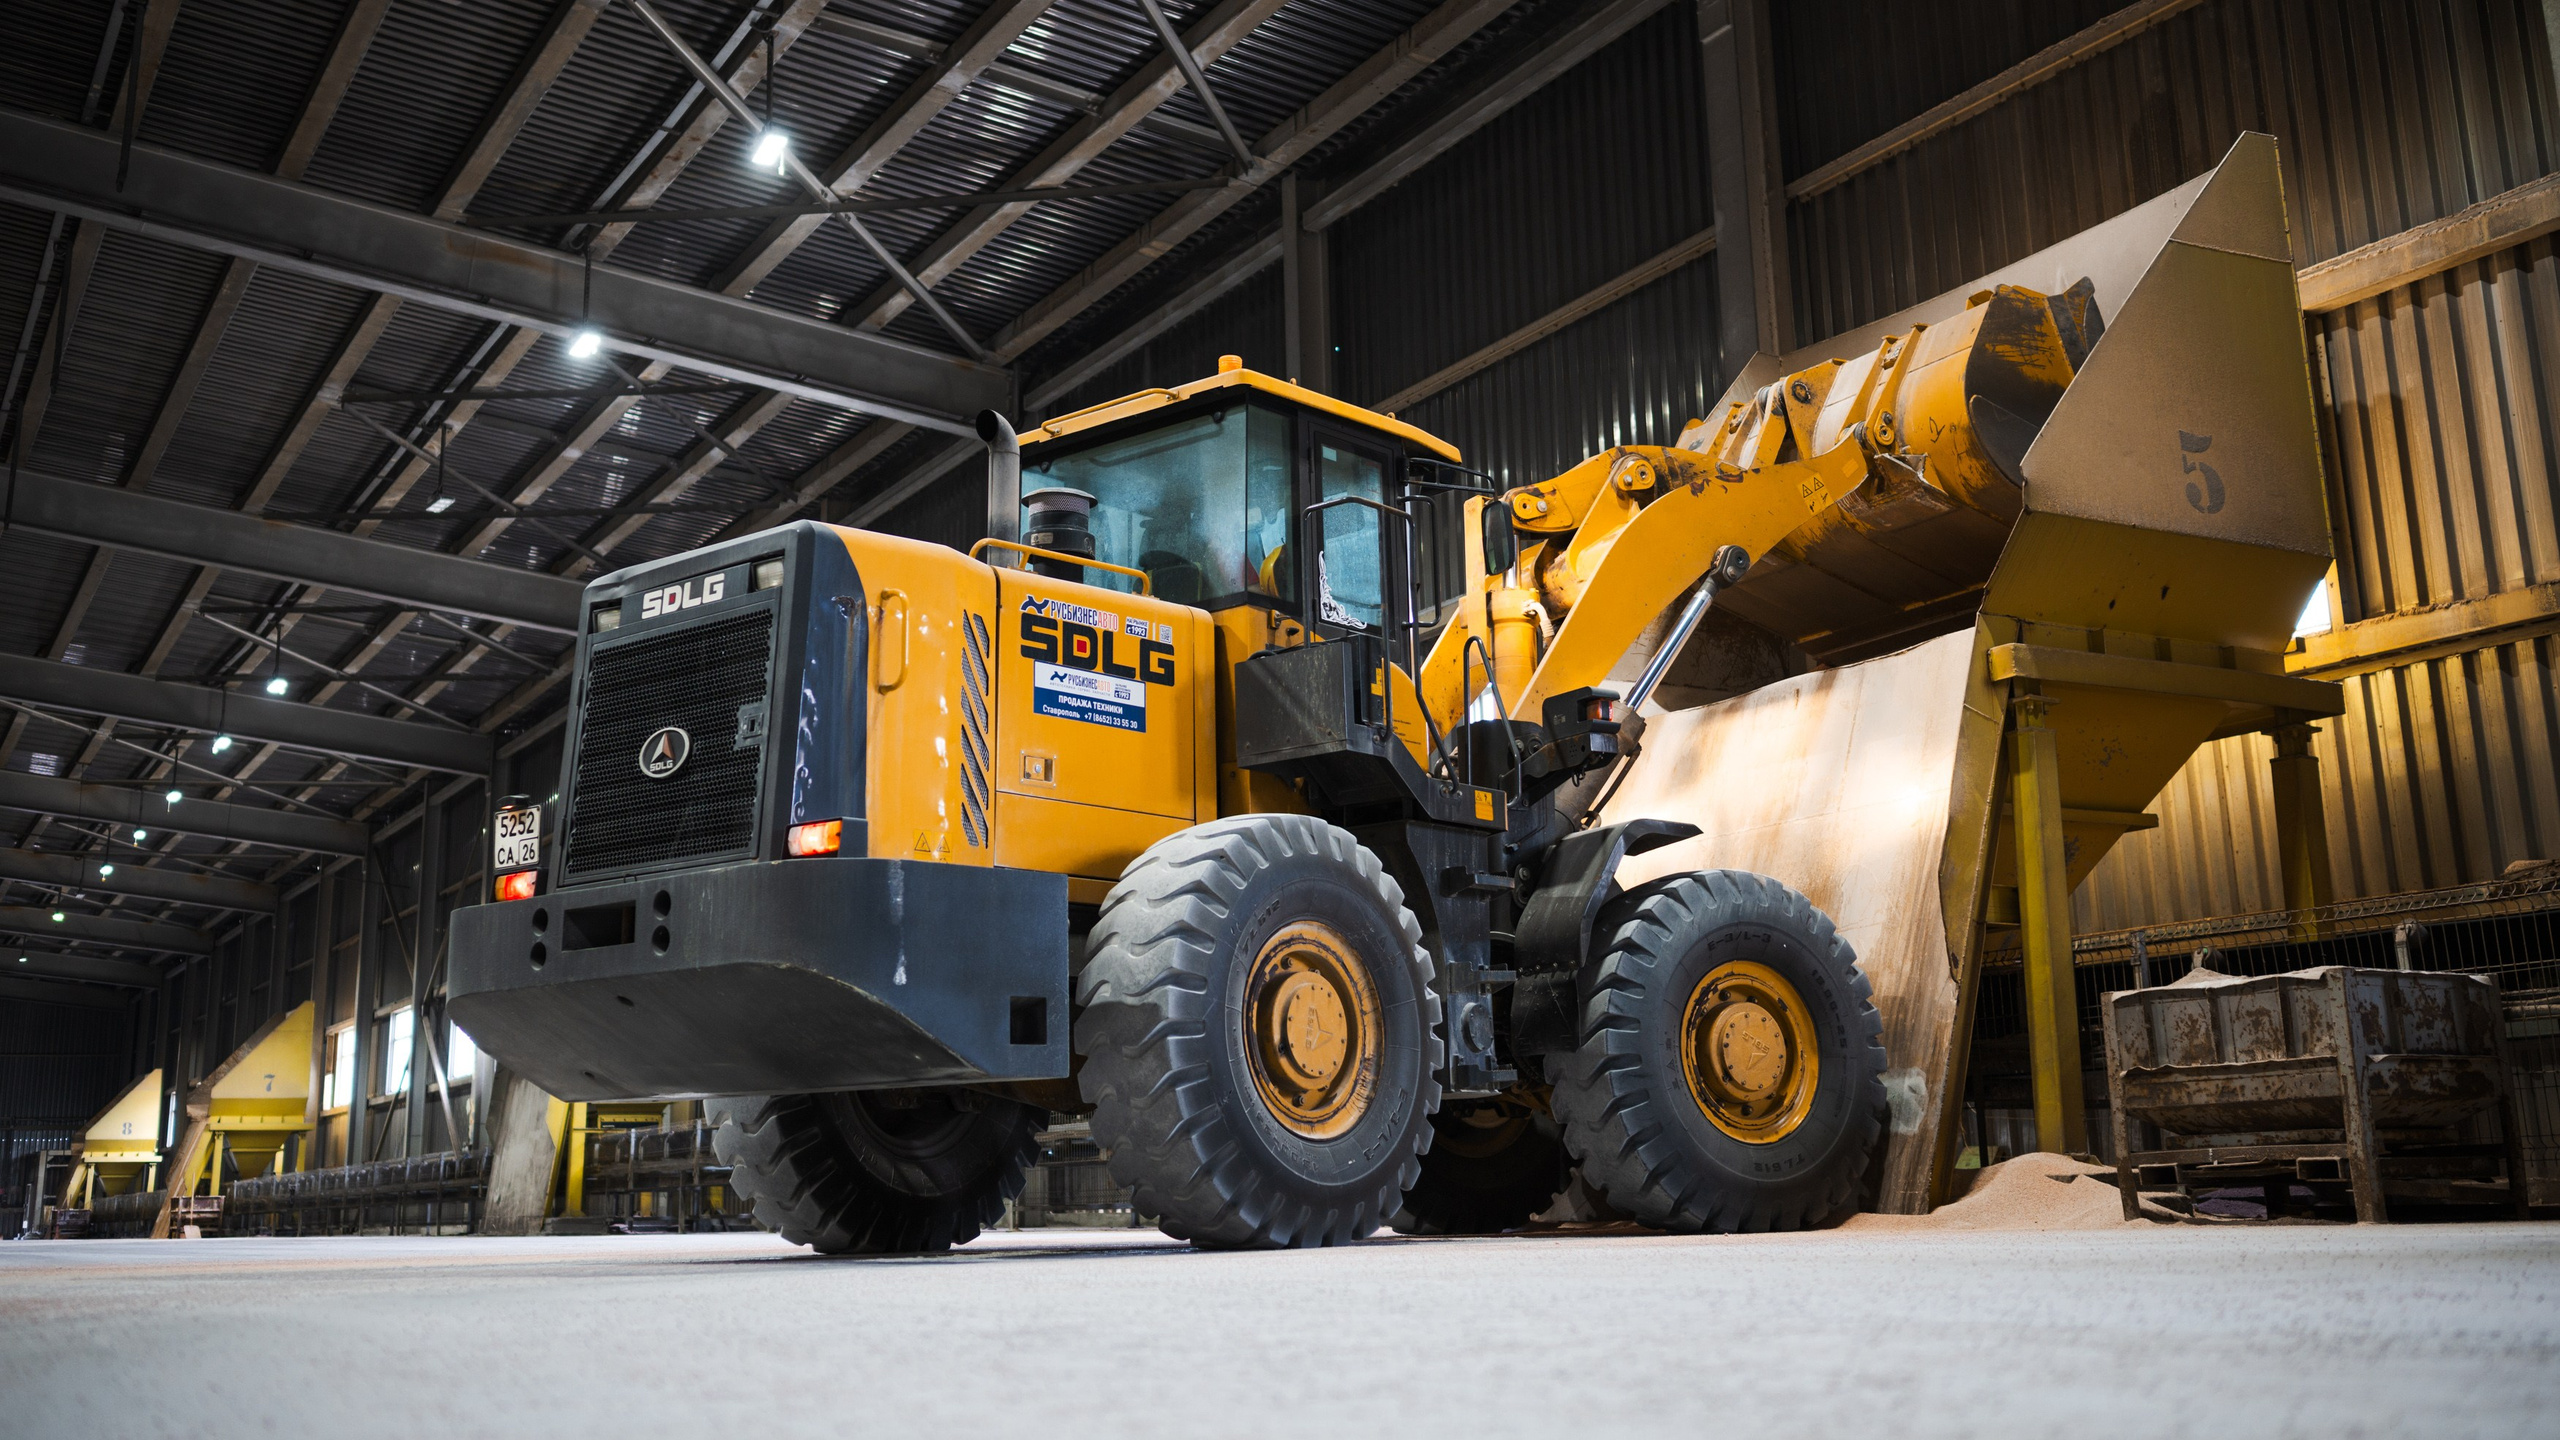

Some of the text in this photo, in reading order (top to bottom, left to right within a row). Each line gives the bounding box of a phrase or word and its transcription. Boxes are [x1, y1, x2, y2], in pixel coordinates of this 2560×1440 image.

[2178, 429, 2226, 515] 5
[641, 573, 725, 620] SDLG
[1050, 600, 1119, 632] РУСБИЗНЕСАВТО
[1020, 612, 1175, 687] SDLG
[1067, 673, 1111, 693] РУСБИЗНЕСАВТО
[1058, 694, 1124, 715] ПРОДАЖА ТЕХНИКИ
[1042, 704, 1081, 719] Ставрополь
[1084, 712, 1093, 721] +7
[1112, 717, 1121, 726] 33
[1121, 718, 1130, 728] 55
[1130, 720, 1138, 729] 30
[649, 760, 674, 773] SDLG
[500, 811, 535, 838] 5252
[522, 842, 536, 862] 26
[264, 1074, 275, 1092] 7
[122, 1122, 132, 1135] 8
